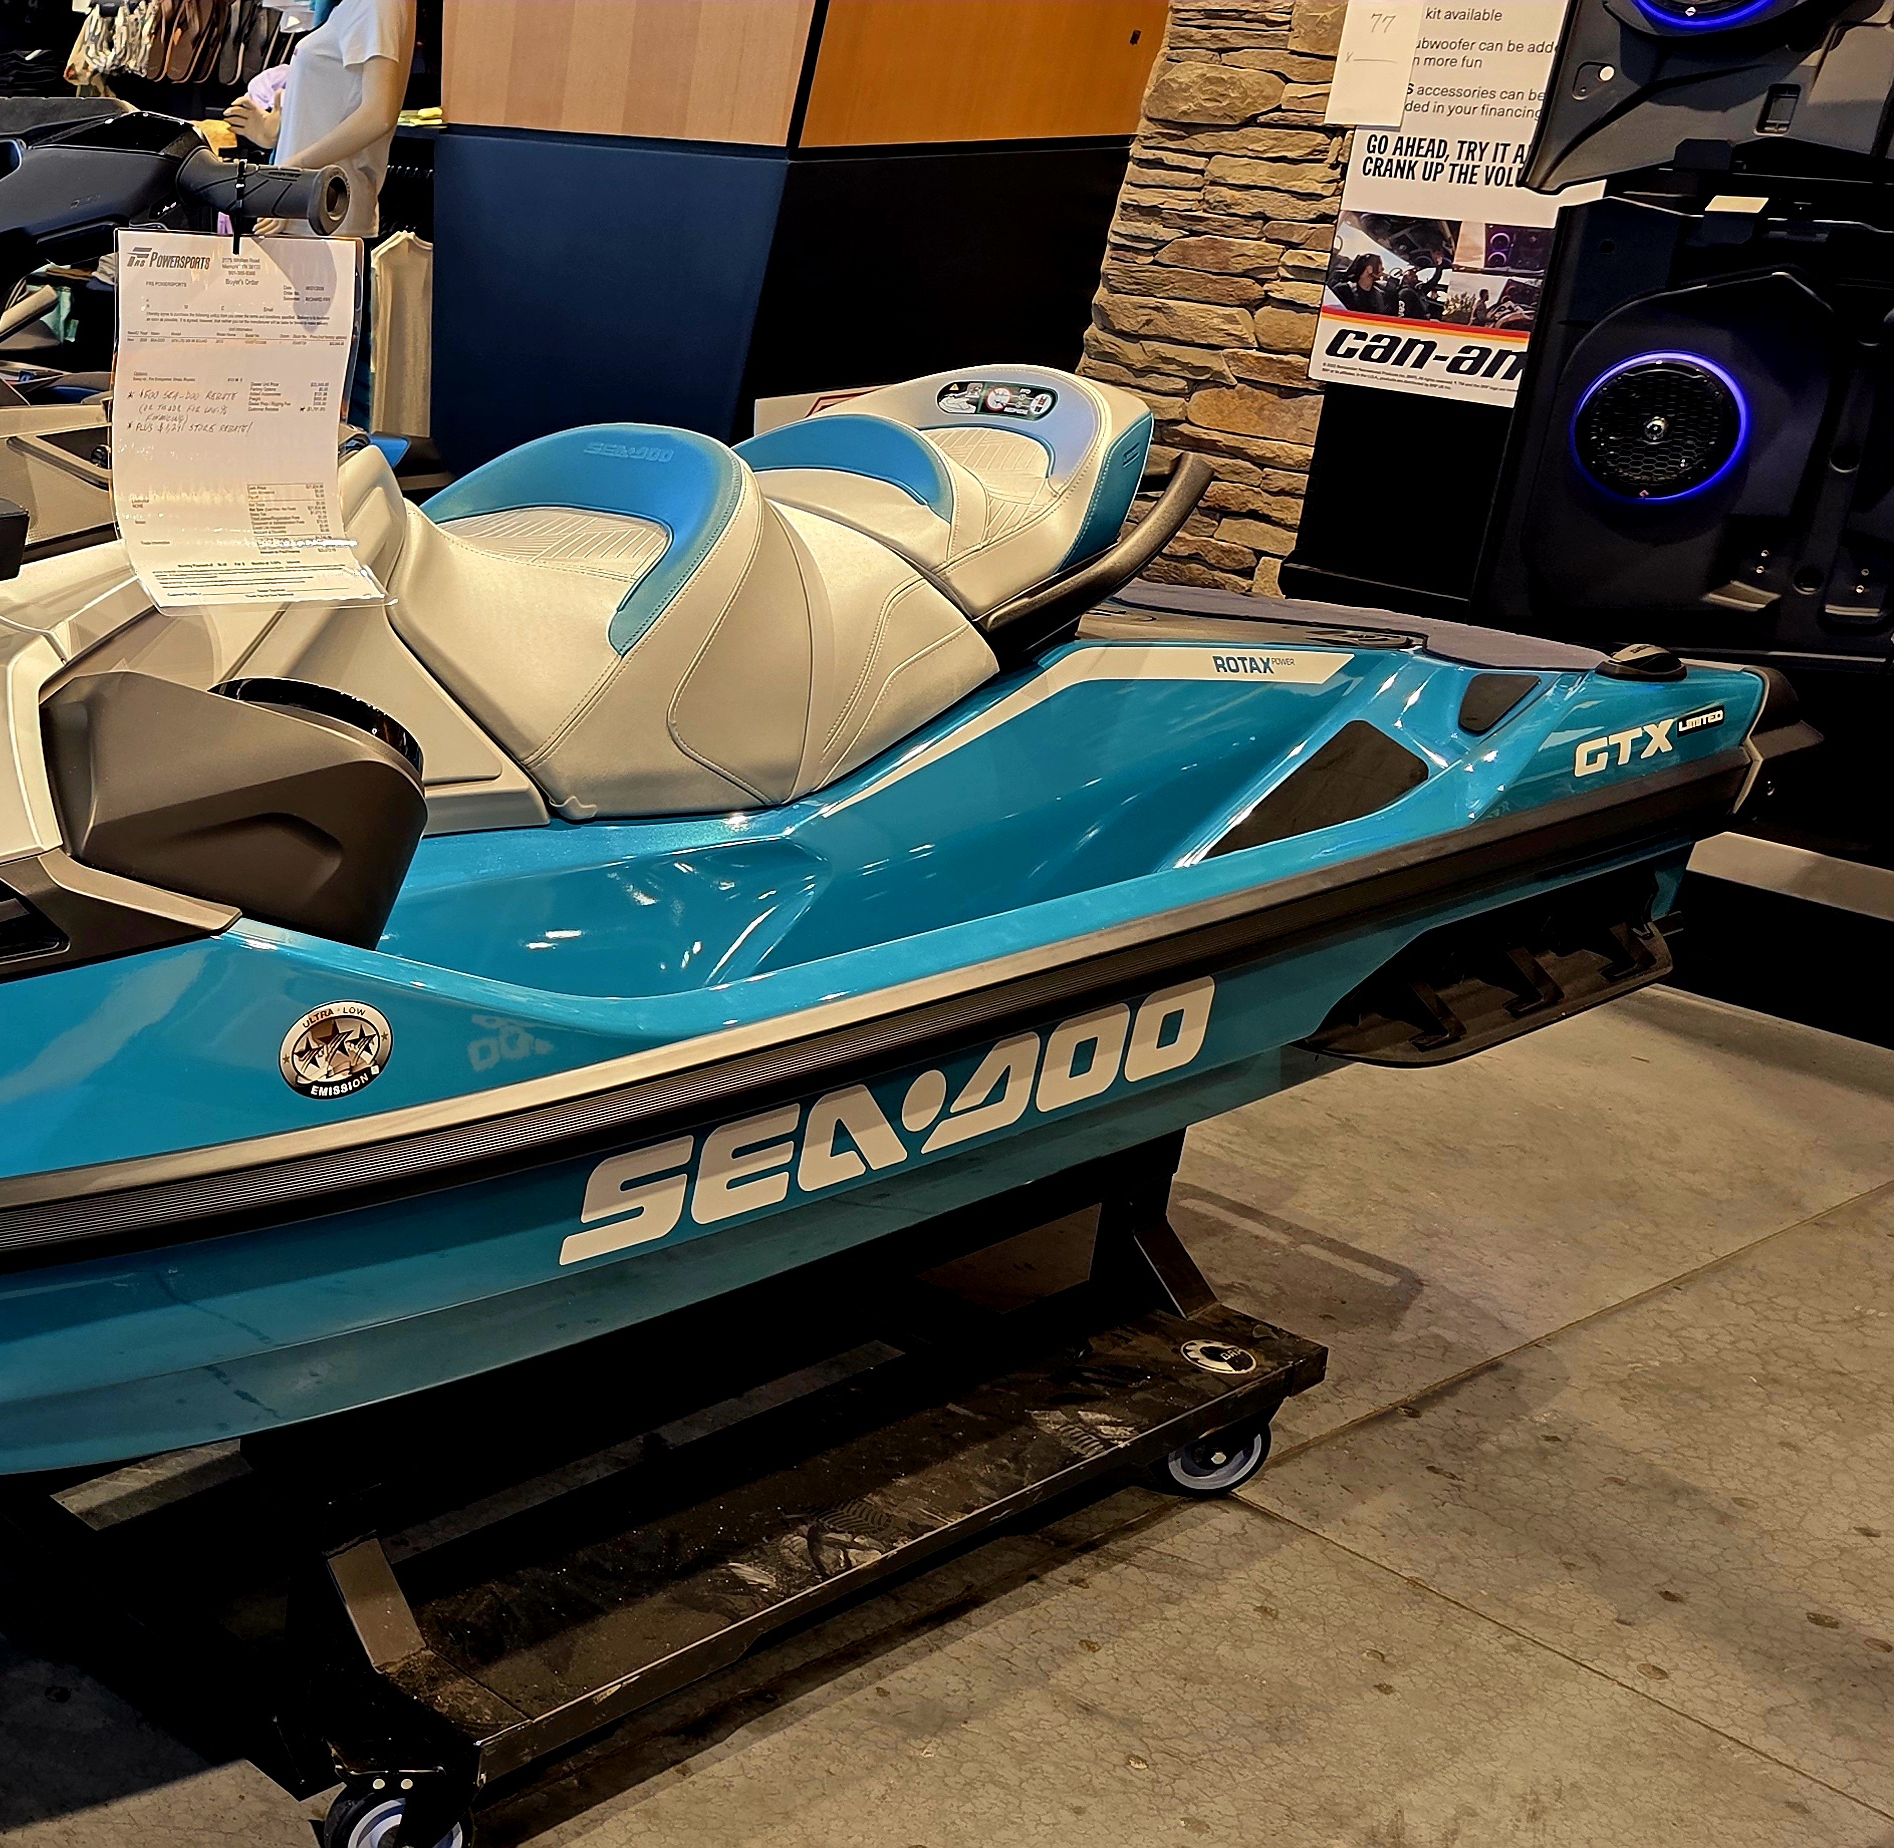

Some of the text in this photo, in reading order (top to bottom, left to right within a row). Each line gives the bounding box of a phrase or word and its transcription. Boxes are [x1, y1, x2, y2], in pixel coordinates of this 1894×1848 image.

[1425, 7, 1503, 21] kit available
[1416, 37, 1476, 51] ubwoofer
[1479, 41, 1502, 52] can
[1506, 38, 1524, 53] be
[1423, 58, 1458, 68] more
[1461, 57, 1482, 68] fun
[1417, 85, 1496, 99] accessories
[1499, 91, 1523, 101] can
[1528, 88, 1546, 101] be
[1432, 102, 1444, 113] in
[1447, 105, 1477, 117] your
[1481, 104, 1542, 121] financing
[1367, 134, 1388, 154] GO
[1392, 136, 1450, 162] AHEAD,
[1456, 140, 1489, 163] TRY
[1492, 142, 1511, 163] IT
[1362, 156, 1418, 180] CRANK
[1421, 161, 1445, 182] UP
[1448, 163, 1480, 185] THE
[1212, 655, 1295, 674] ROTAX POWER
[1574, 709, 1724, 778] GTX LIMITED
[302, 1006, 366, 1028] ULTRA LOW
[310, 1072, 369, 1097] EMISSION
